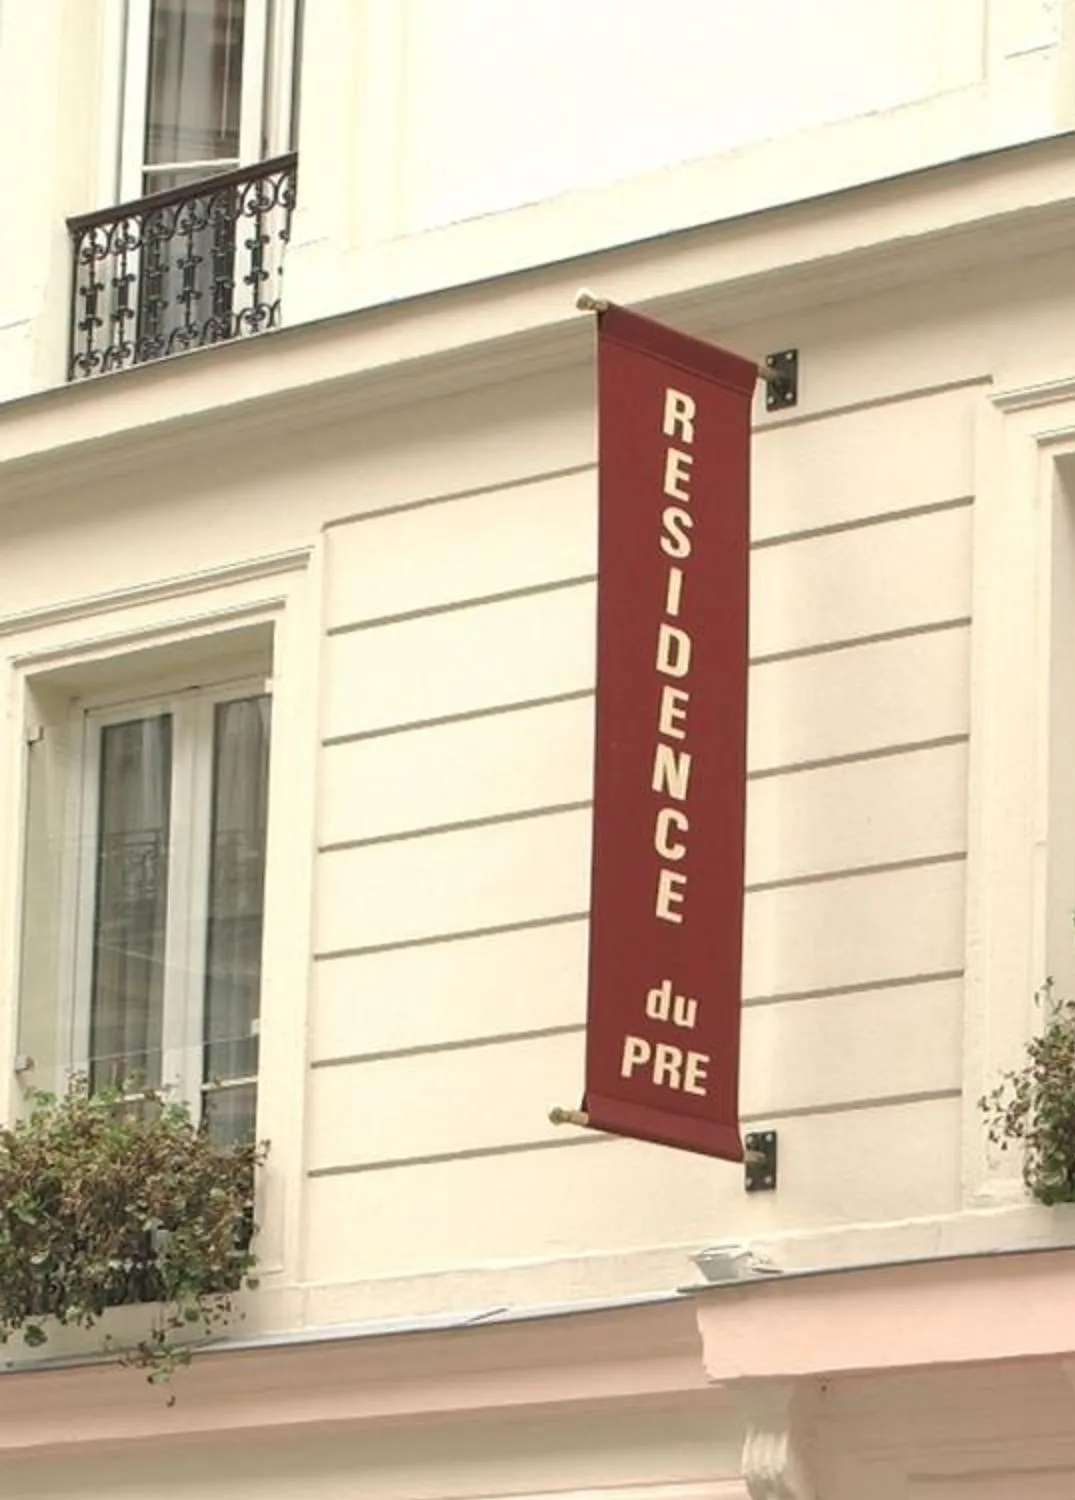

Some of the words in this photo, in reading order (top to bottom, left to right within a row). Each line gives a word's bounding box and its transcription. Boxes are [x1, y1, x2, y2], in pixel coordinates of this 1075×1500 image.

[651, 387, 697, 925] RESIDENCE
[645, 979, 698, 1029] du
[620, 1035, 711, 1097] PRE
